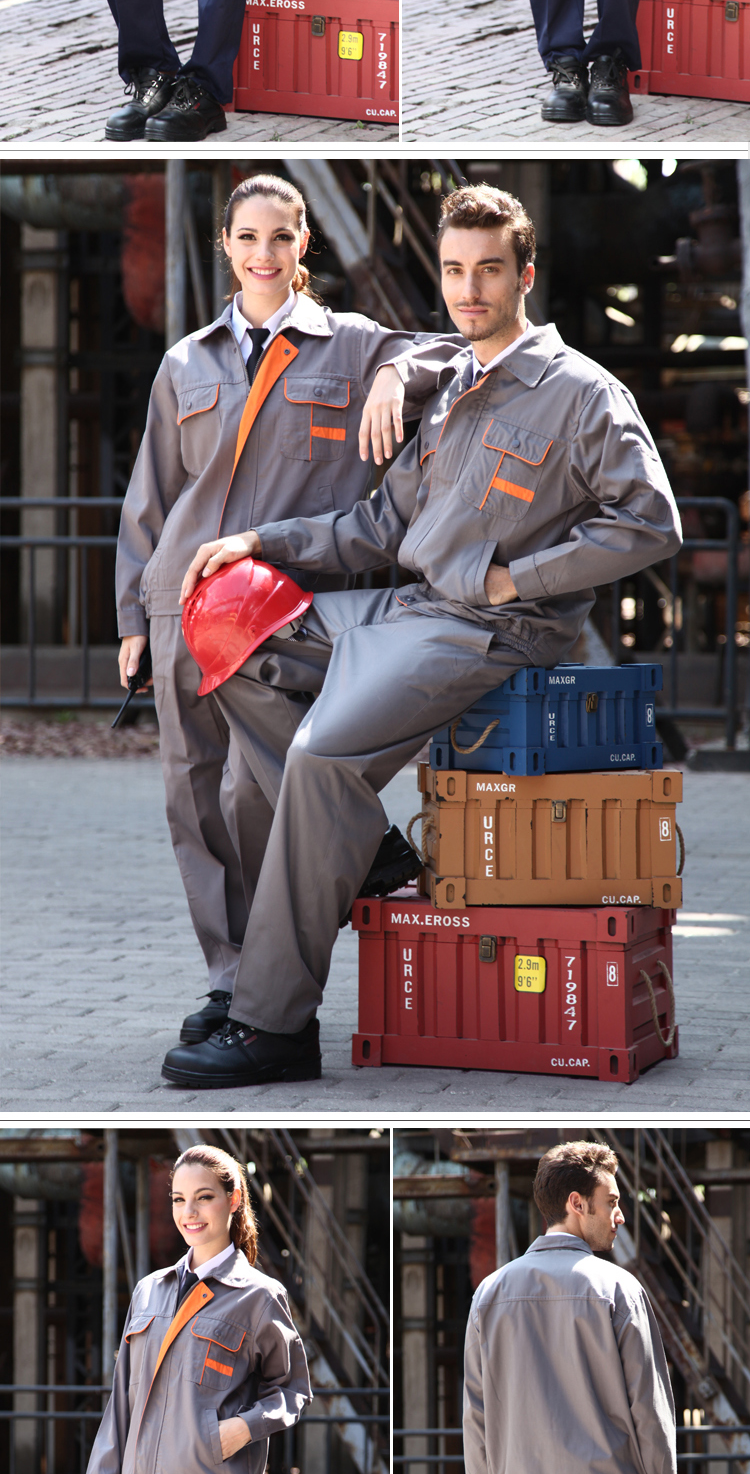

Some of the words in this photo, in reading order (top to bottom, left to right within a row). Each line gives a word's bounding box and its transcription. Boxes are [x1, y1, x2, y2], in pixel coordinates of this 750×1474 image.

[666, 7, 675, 54] URCE
[341, 33, 359, 44] 2.9m
[252, 23, 261, 70] URCE
[376, 32, 388, 90] 719847
[365, 108, 397, 117] CU.CAP.
[548, 675, 576, 685] MAXGR
[548, 713, 556, 741] URCE
[609, 753, 637, 762] CU.CAP.
[476, 782, 517, 792] MAXGR
[483, 816, 494, 877] URCE
[601, 895, 642, 904] CU.CAP.
[390, 913, 471, 928] MAX.EROSS
[518, 958, 539, 971] 2.9m
[402, 948, 413, 1010] URCE
[563, 956, 578, 1031] 719847
[550, 1058, 591, 1068] CU.CAP.
